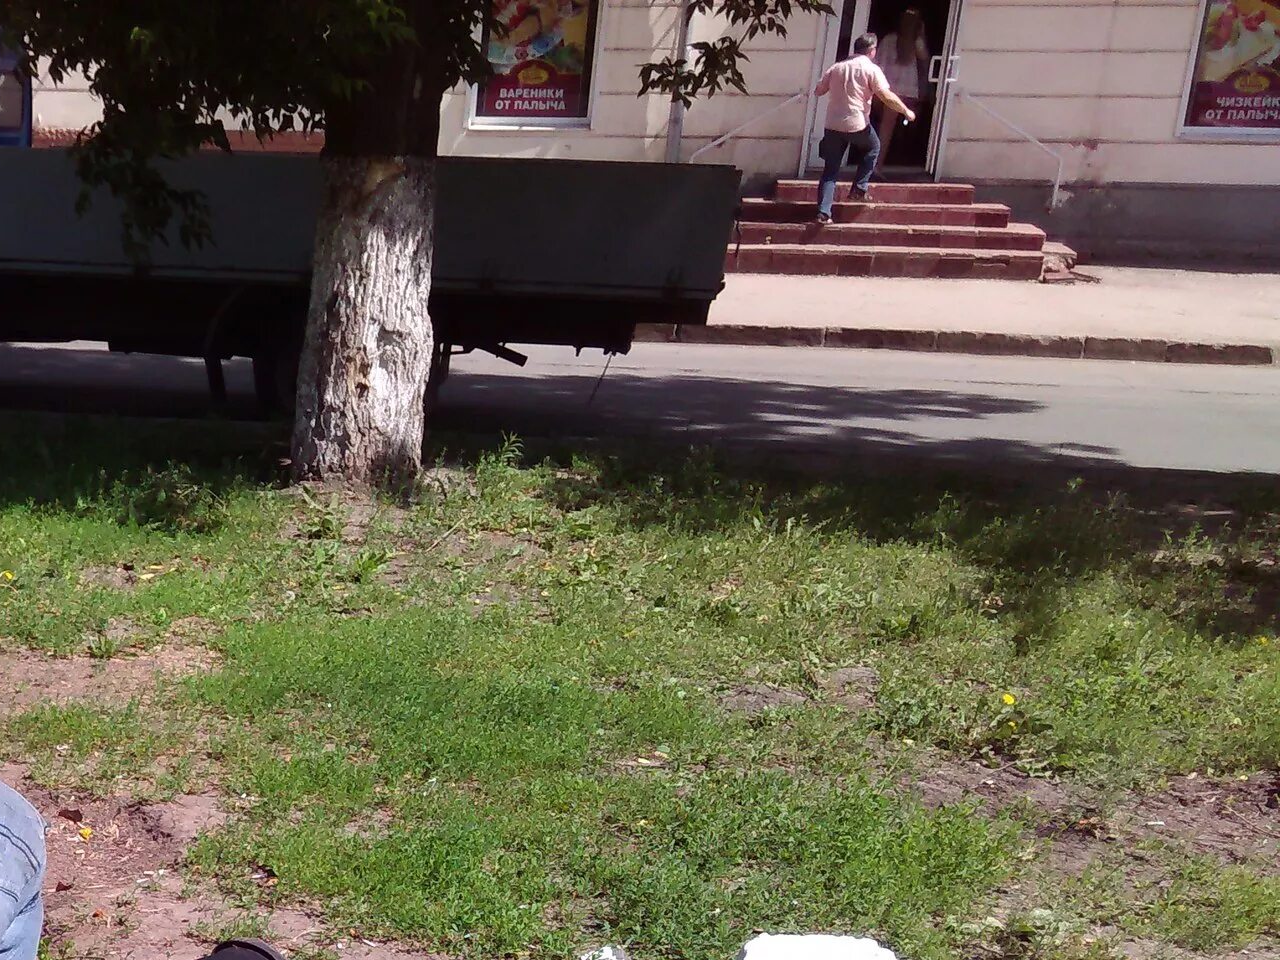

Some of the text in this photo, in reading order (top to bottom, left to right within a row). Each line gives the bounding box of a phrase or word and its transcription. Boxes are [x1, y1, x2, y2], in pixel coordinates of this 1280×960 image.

[499, 88, 564, 99] ВАРЕНИКИ
[495, 100, 566, 110] ОТ ПАЛЫЧА
[1205, 109, 1280, 120] ОТ ПАЛЫЧ
